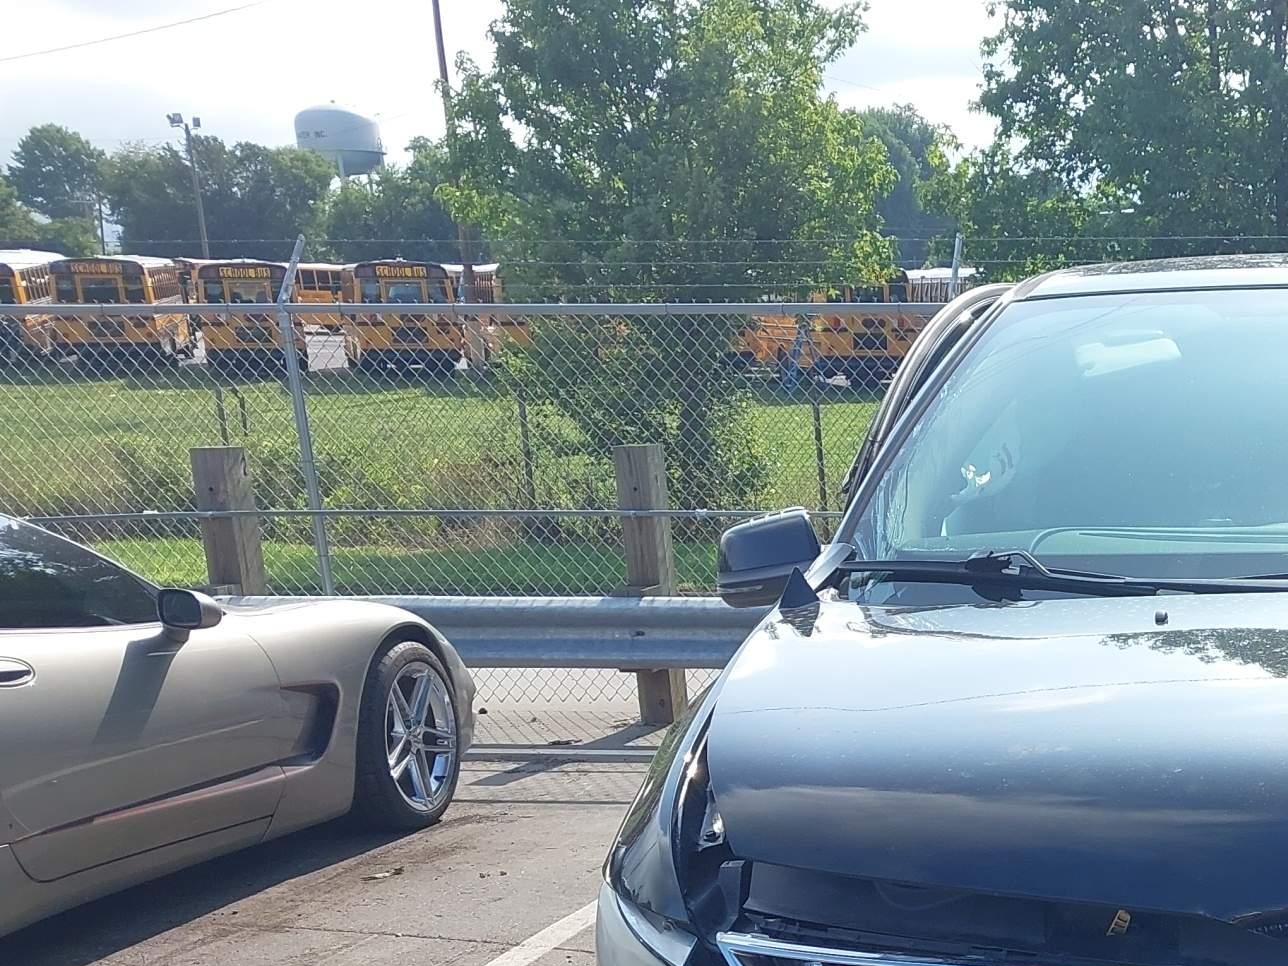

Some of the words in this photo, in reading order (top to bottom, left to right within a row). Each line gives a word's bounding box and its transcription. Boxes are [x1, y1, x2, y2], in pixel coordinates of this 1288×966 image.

[71, 264, 103, 274] SCHOOL
[106, 264, 121, 274] BUS
[220, 268, 252, 278] SCHOOL
[255, 268, 269, 278] BUS
[377, 267, 409, 277] SCHOOL
[411, 267, 425, 277] BUS
